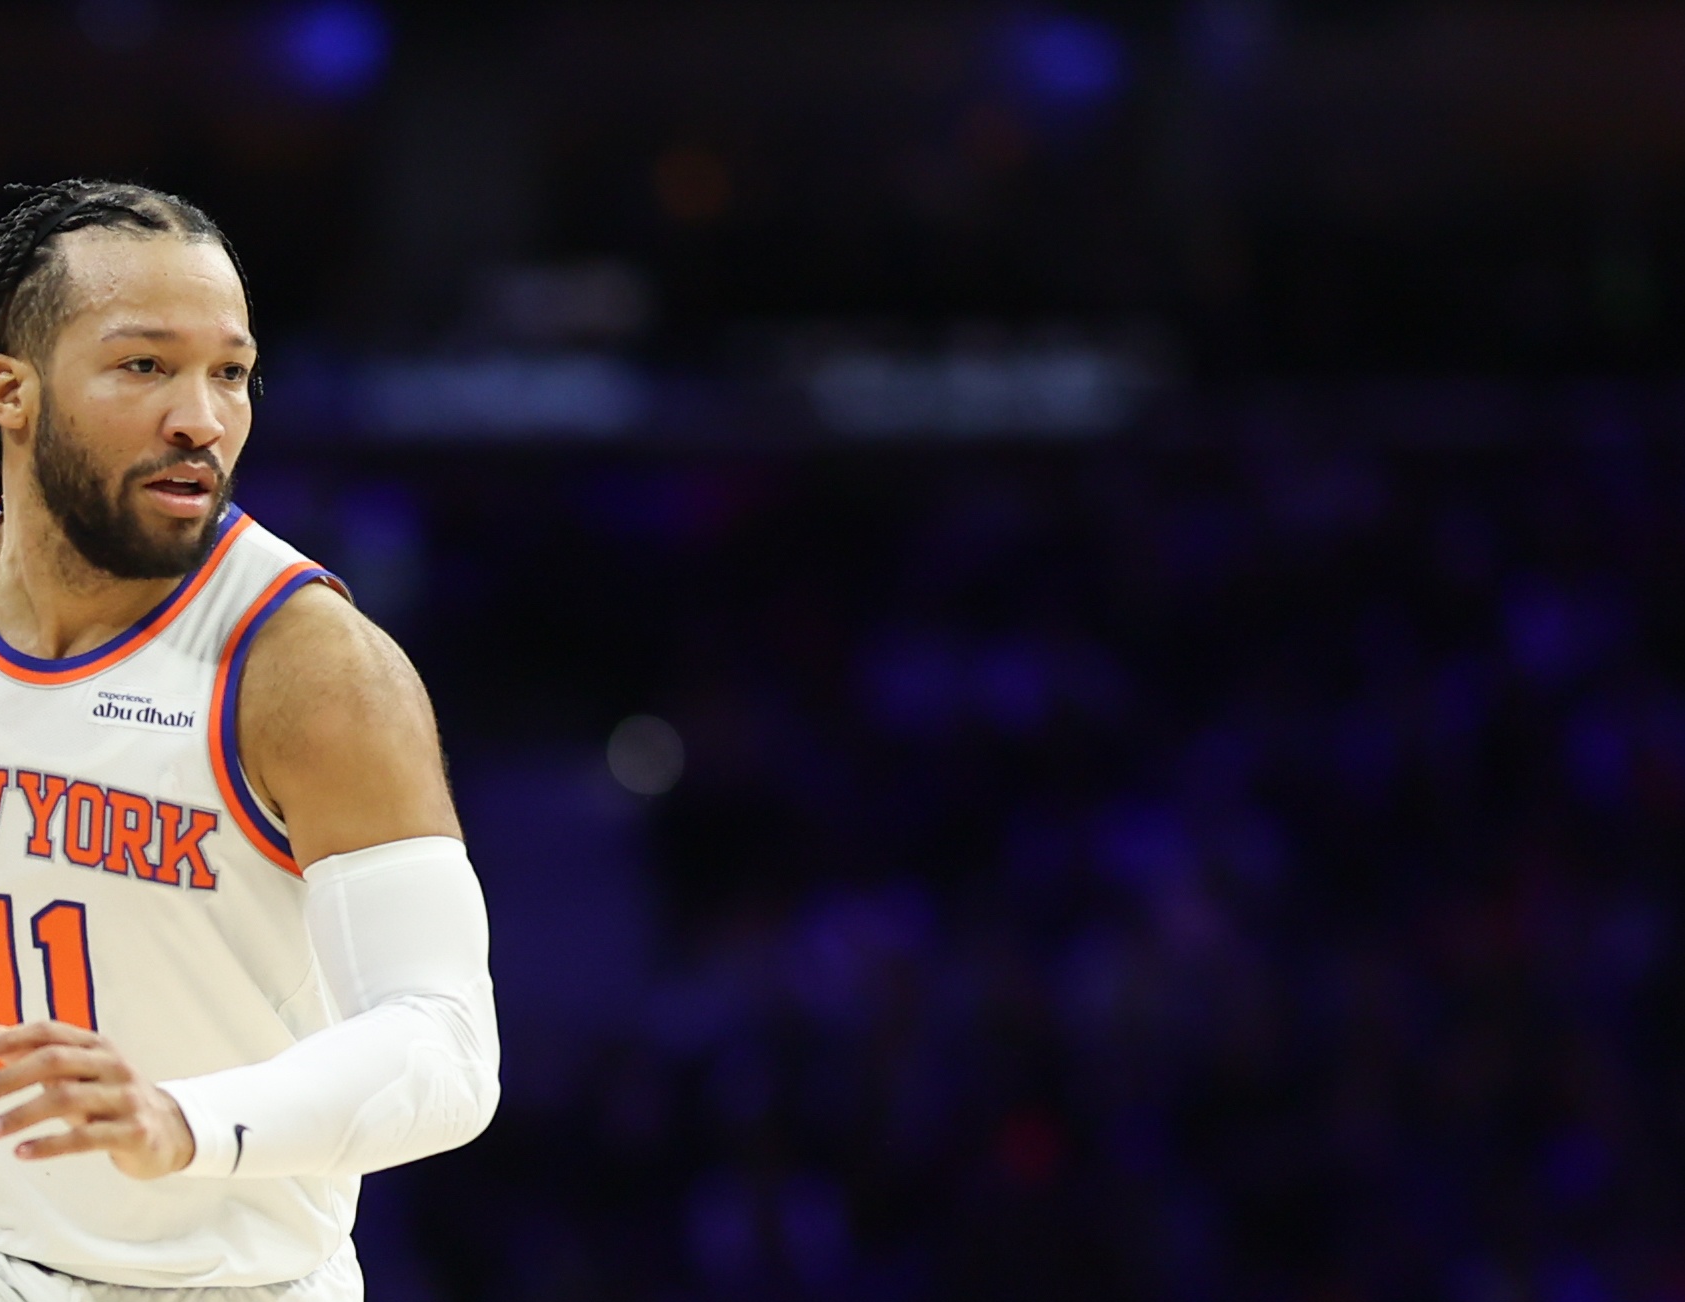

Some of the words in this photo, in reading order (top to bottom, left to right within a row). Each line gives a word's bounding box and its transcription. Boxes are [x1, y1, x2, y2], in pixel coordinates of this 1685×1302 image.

[97, 691, 153, 704] experience
[92, 702, 133, 721] abu
[136, 707, 196, 728] dhabi
[15, 770, 220, 891] YORK
